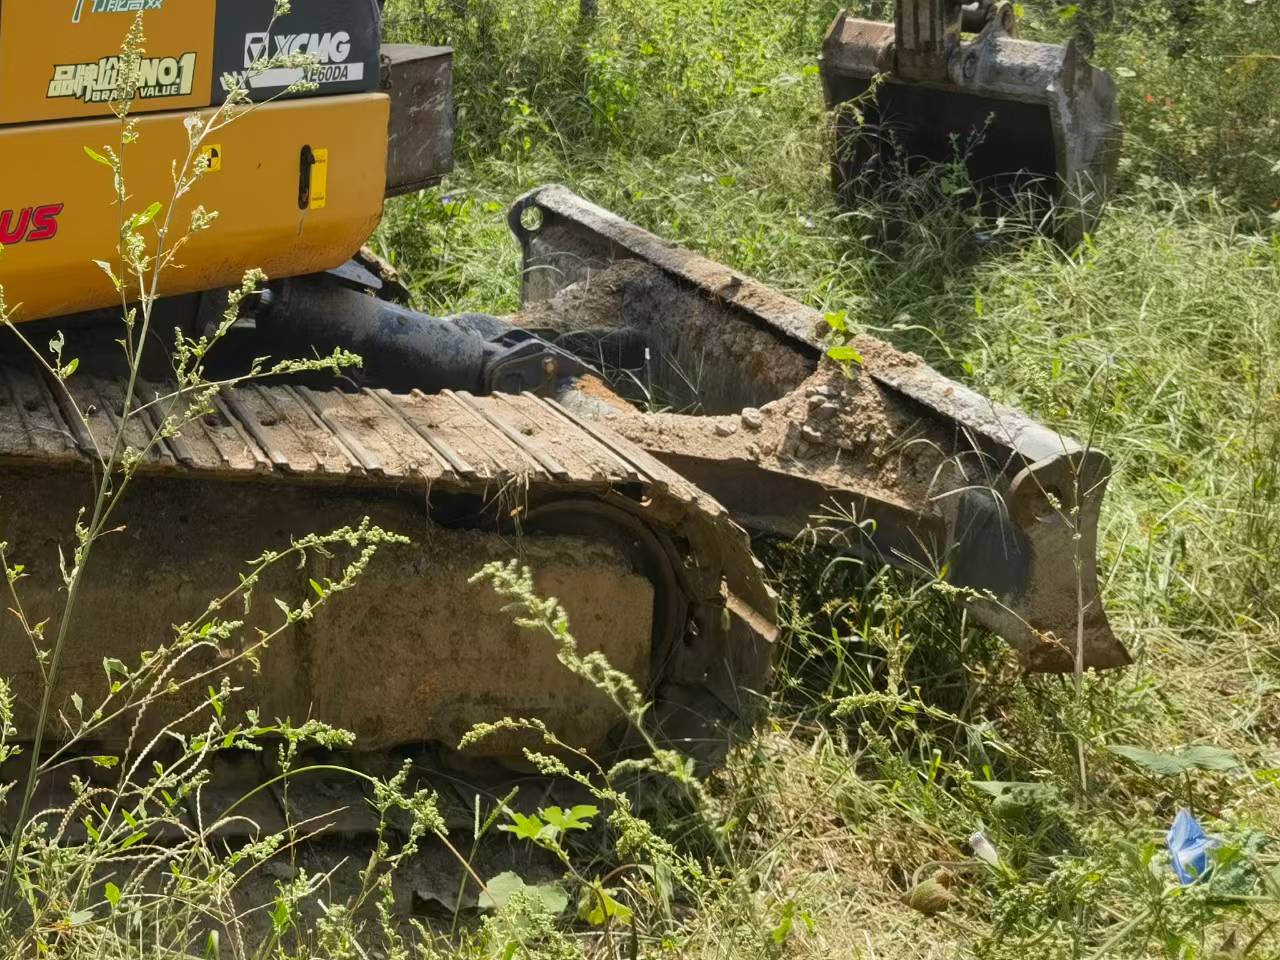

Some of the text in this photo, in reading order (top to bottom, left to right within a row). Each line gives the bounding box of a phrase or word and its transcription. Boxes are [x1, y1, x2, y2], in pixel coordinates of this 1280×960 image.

[271, 31, 351, 63] XCMG
[47, 56, 139, 102] 品牌价
[140, 85, 179, 98] VALUE
